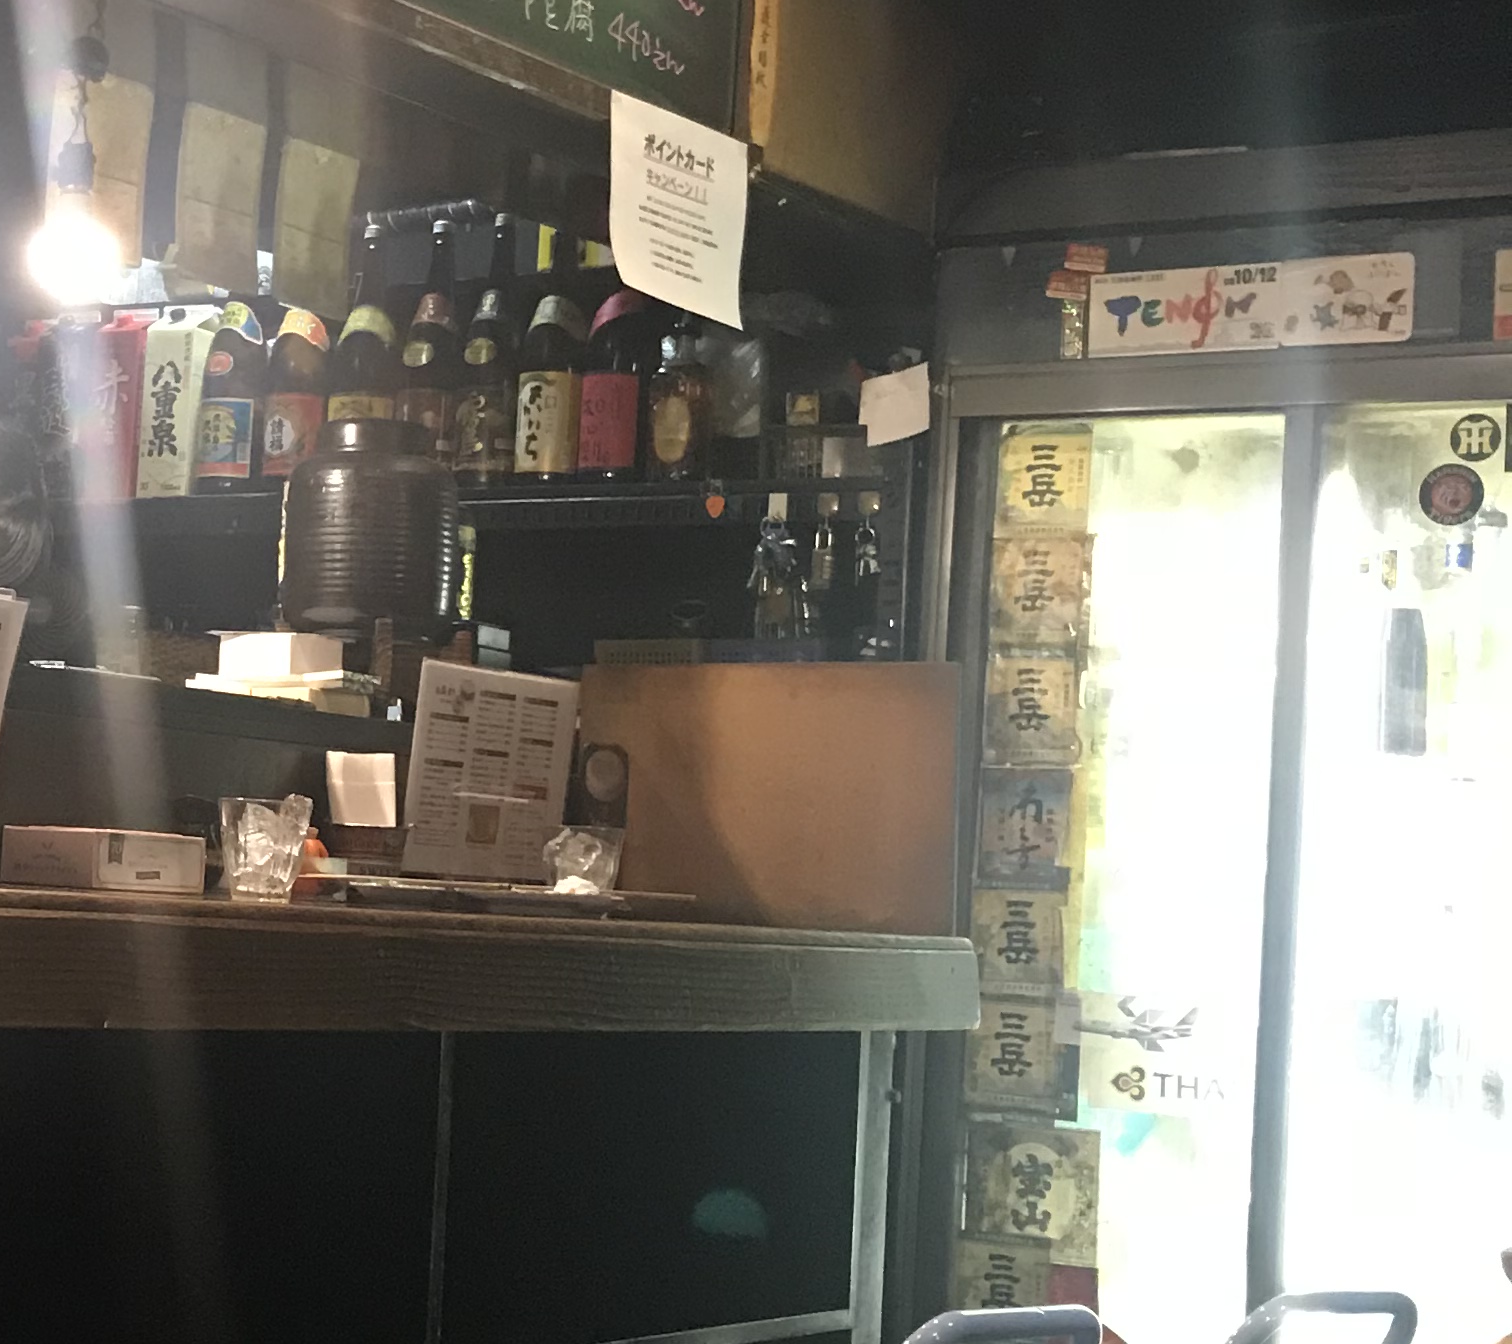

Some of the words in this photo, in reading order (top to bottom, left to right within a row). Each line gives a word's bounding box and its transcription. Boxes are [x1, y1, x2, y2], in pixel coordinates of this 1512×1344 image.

[147, 359, 183, 458] 八重泉
[1022, 443, 1065, 508] 三岳
[1013, 550, 1056, 612] 三岳
[1008, 667, 1051, 732] 三岳
[996, 899, 1040, 965] 三岳
[990, 1011, 1033, 1078] 三岳
